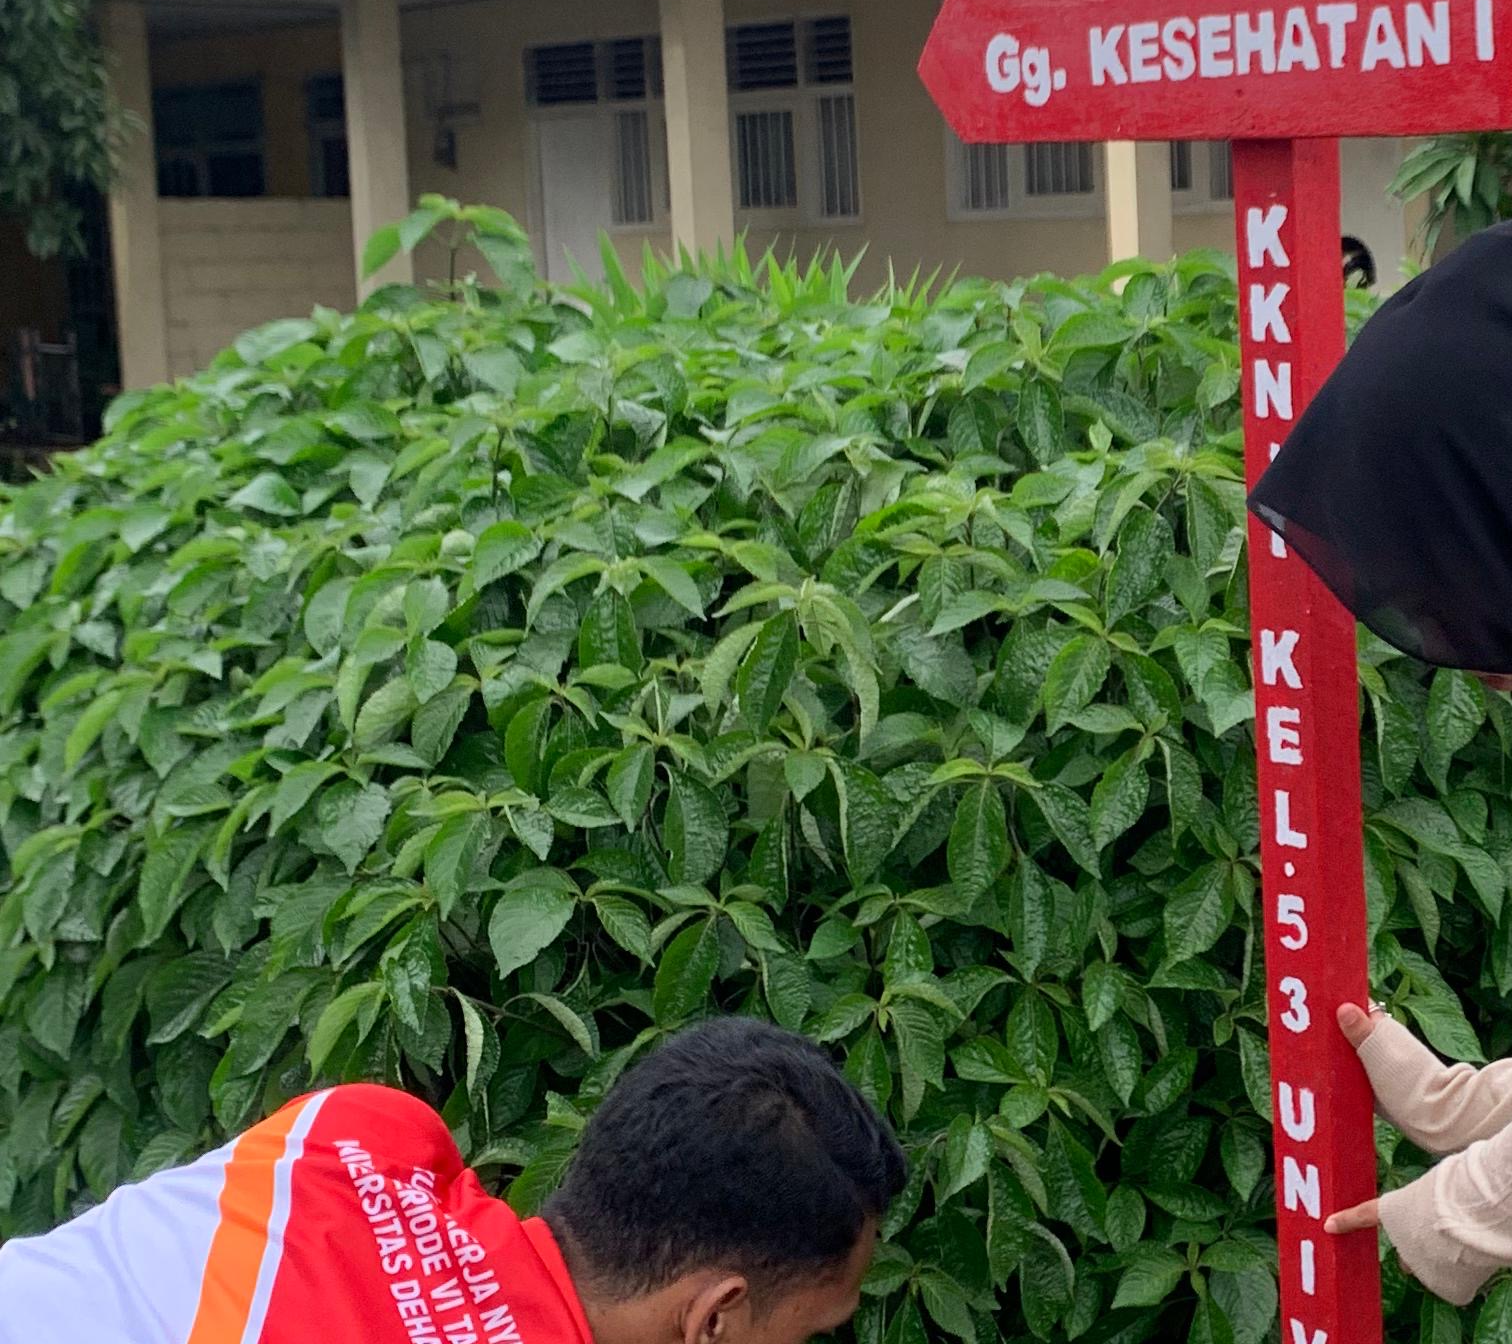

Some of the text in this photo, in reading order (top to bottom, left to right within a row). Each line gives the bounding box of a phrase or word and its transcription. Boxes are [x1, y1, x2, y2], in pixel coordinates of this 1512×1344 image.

[985, 34, 1067, 107] Gg.
[1090, 1, 1450, 86] KESEHATAN
[430, 1277, 465, 1312] VI
[444, 1213, 500, 1304] ERJA
